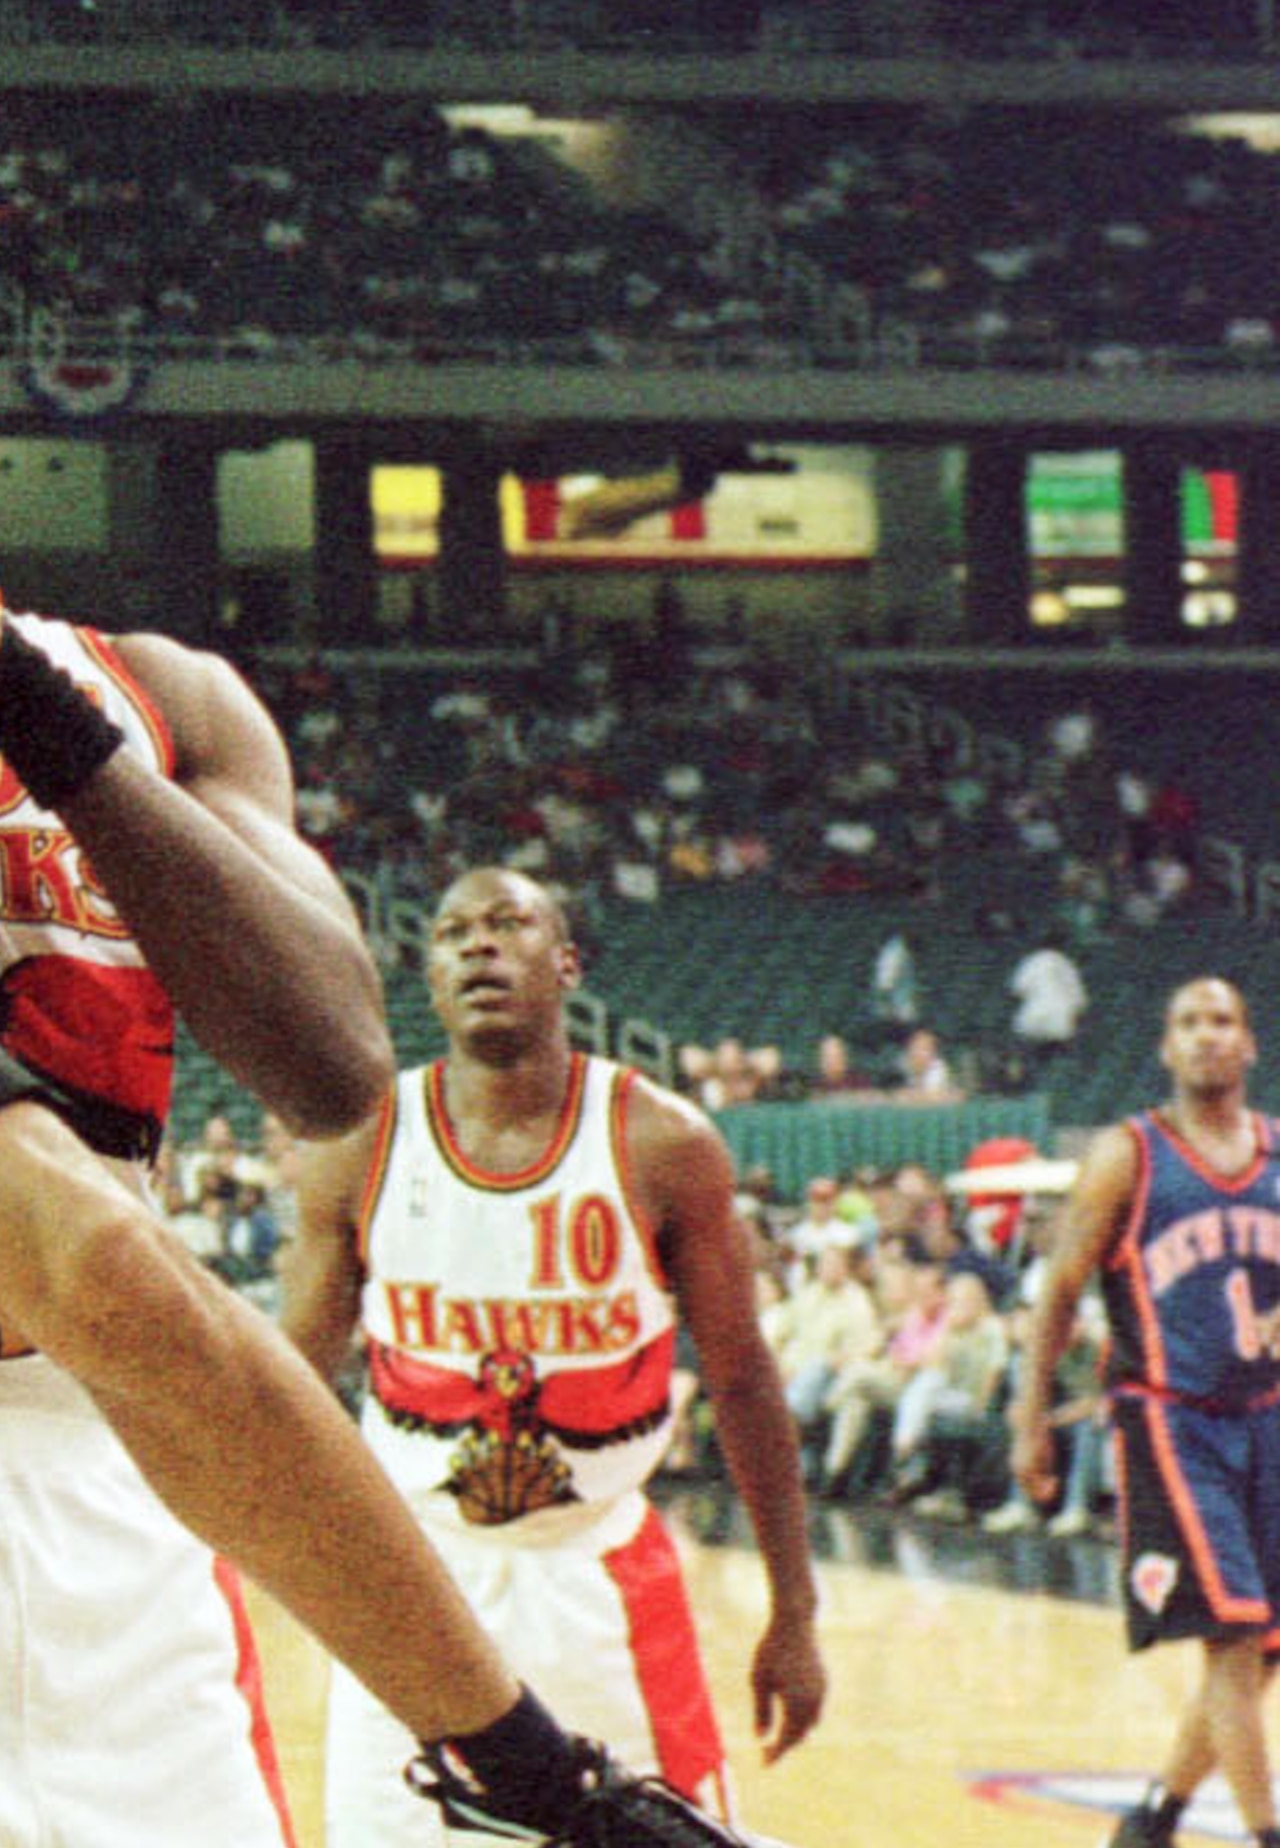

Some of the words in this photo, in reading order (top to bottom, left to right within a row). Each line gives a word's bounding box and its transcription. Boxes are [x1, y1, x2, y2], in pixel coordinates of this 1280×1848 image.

[528, 1192, 623, 1290] 10
[1144, 1208, 1223, 1299] NEW
[383, 1281, 643, 1356] HAWKS
